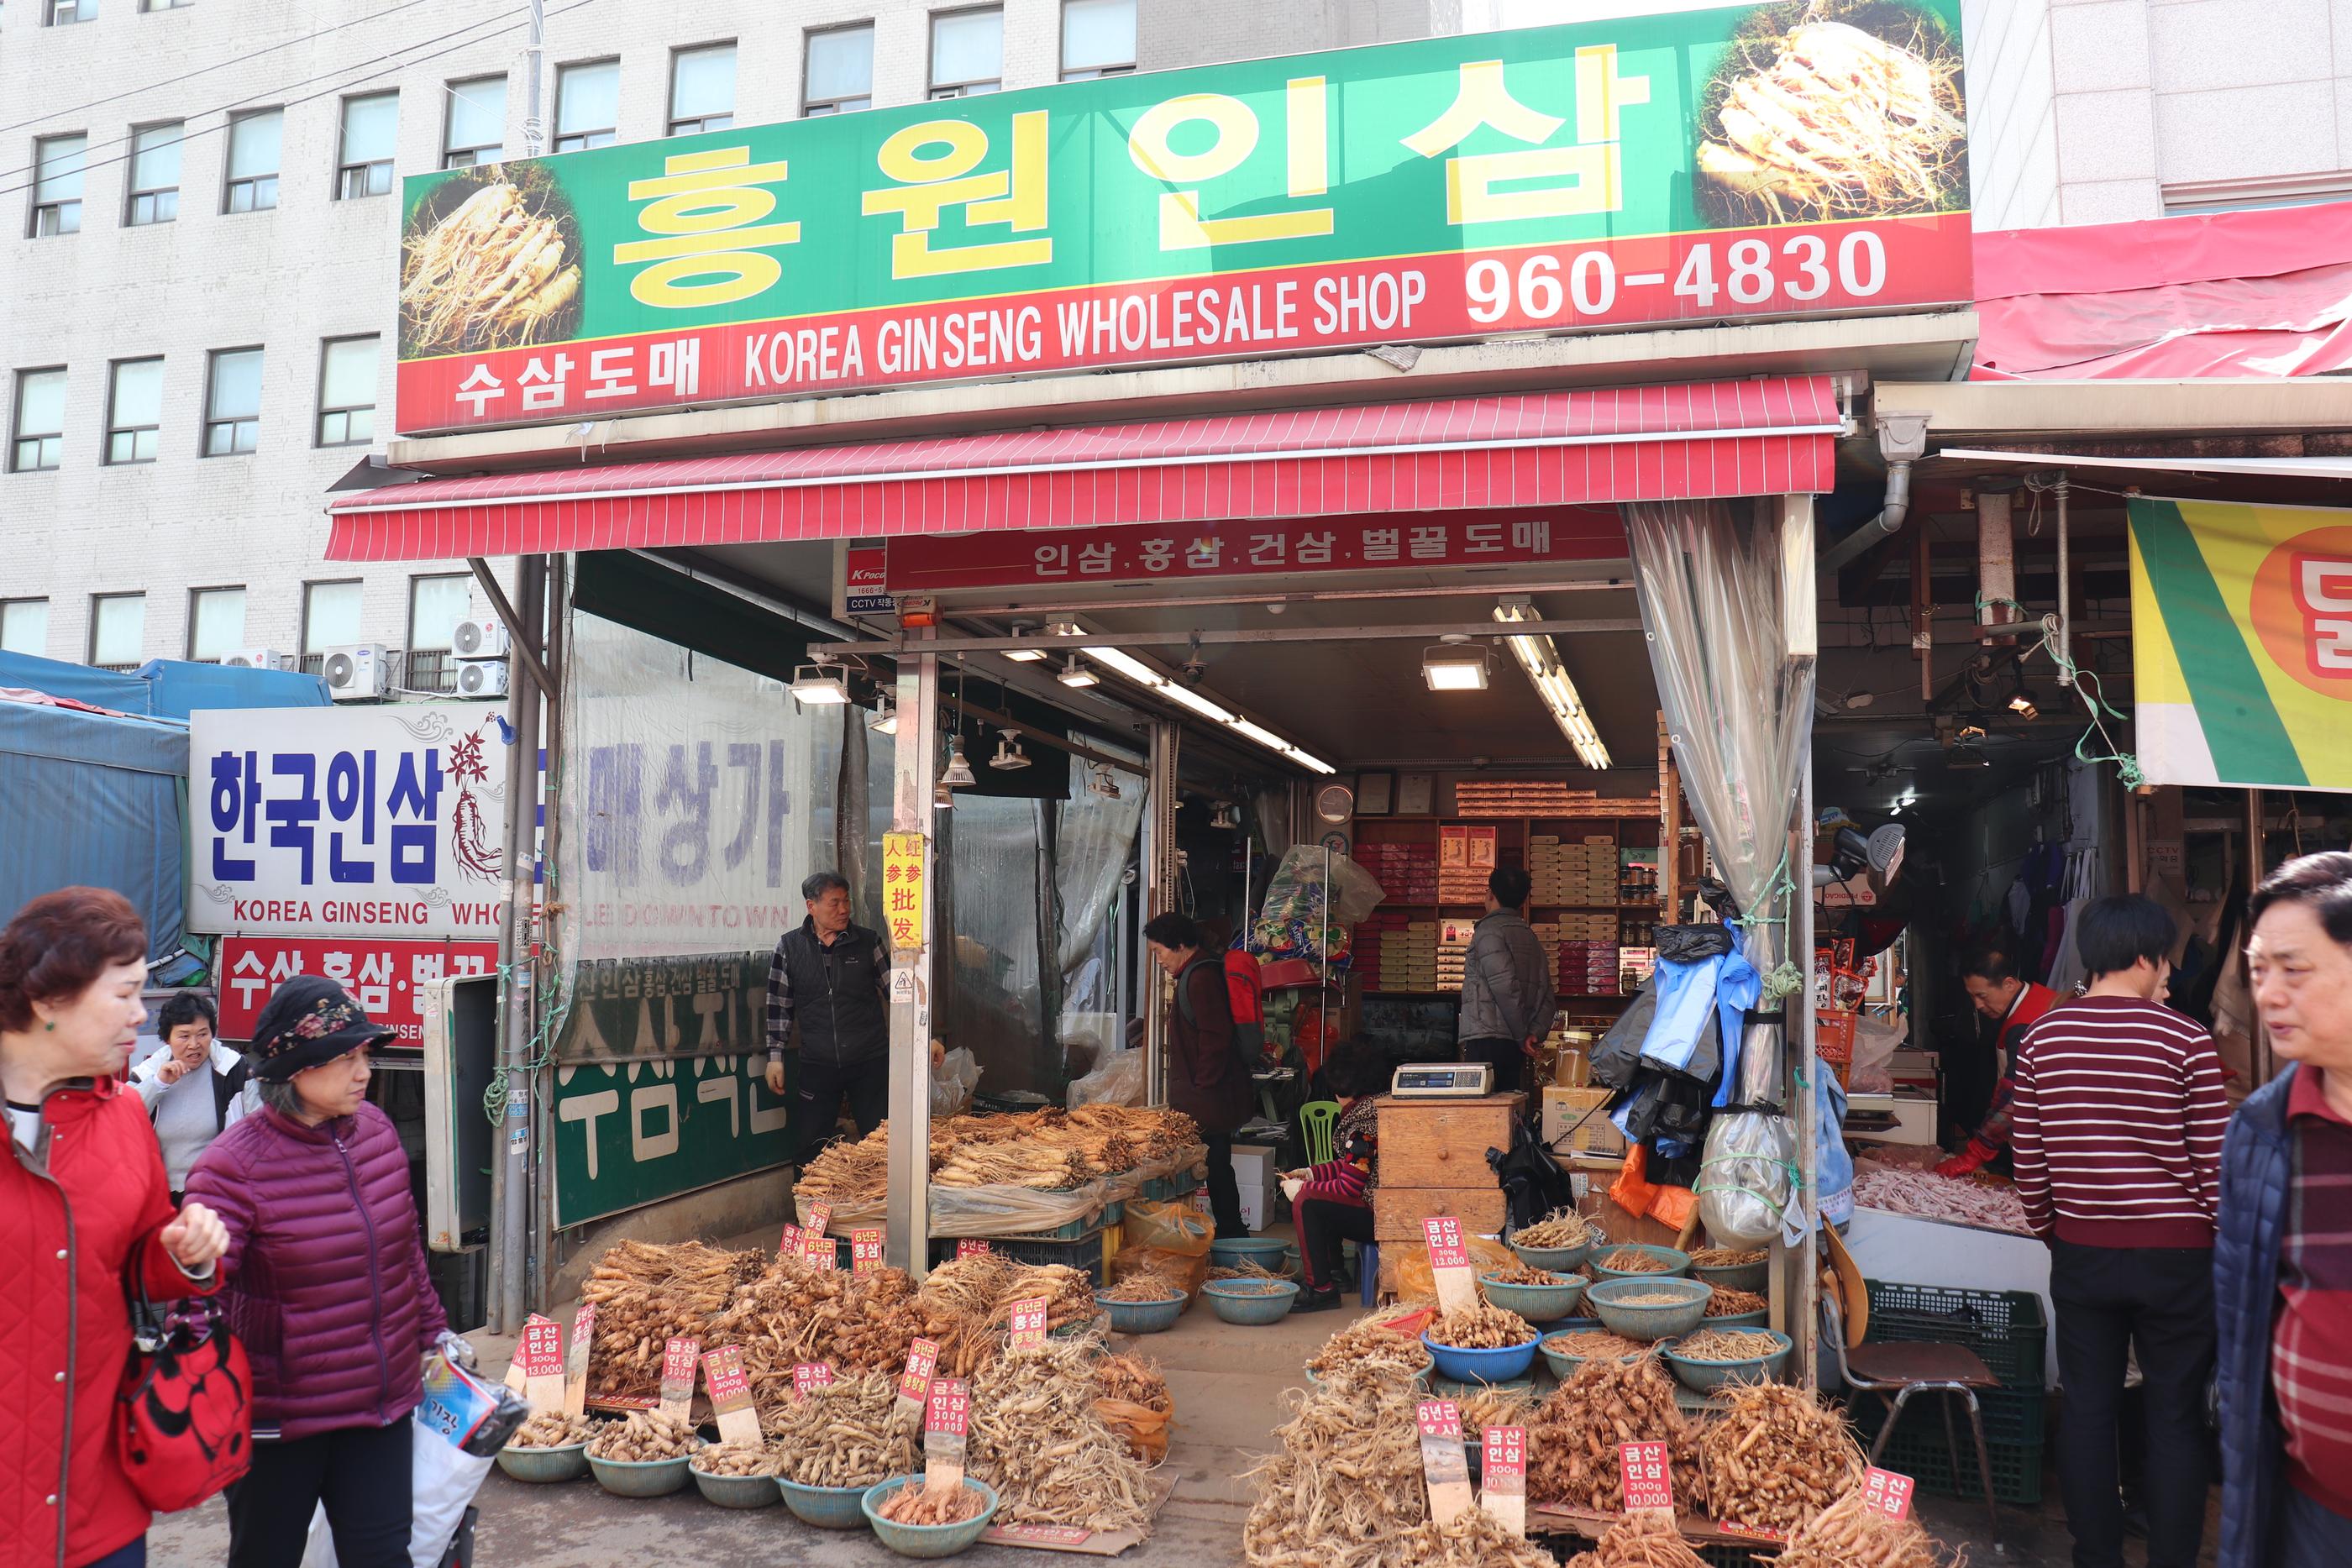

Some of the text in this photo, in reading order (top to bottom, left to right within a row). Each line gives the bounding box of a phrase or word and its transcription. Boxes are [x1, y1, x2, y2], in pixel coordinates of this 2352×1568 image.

[612, 44, 1651, 308] 흥원인삼
[745, 231, 1887, 387] KOREA GINSENG WHOLESALE SHOP 960-4830
[455, 338, 700, 417] 수삼도매
[1464, 521, 1551, 553] 도매
[851, 599, 876, 609] CCTV
[211, 739, 790, 888] 한국인삼 매상가
[234, 900, 313, 922] KOREA
[323, 901, 429, 924] GINSENG
[812, 1204, 828, 1217] 6년근
[807, 1214, 825, 1231] 홍삼
[1427, 1220, 1457, 1233] 금산
[855, 1231, 878, 1242] 6년근
[1429, 1234, 1459, 1247] 인삼
[807, 1241, 832, 1253] 6년근
[854, 1243, 879, 1259] 홍삼
[959, 1238, 988, 1251] 6년근
[1435, 1256, 1465, 1266] 12.000
[1016, 1301, 1042, 1314] 6년근
[1014, 1313, 1043, 1330] 홍삼
[528, 1326, 557, 1340] 금산
[528, 1340, 558, 1354] 인삼
[669, 1340, 696, 1354] 금산
[914, 1342, 935, 1359] 6년근
[668, 1354, 696, 1368] 인삼
[707, 1349, 738, 1366] 금산
[527, 1364, 562, 1376] 13.000
[667, 1366, 691, 1377] 300g
[711, 1363, 740, 1381] 인삼
[796, 1366, 827, 1378] 금산
[908, 1355, 932, 1377] 홍삼
[716, 1377, 742, 1389] 300g
[933, 1382, 964, 1395] 금산
[932, 1397, 966, 1411] 인삼
[934, 1412, 963, 1422] 300g
[1418, 1403, 1456, 1421] 6년근
[1488, 1430, 1521, 1445] 금산
[1488, 1447, 1521, 1463] 인삼
[1625, 1445, 1661, 1462] 금산
[1489, 1465, 1519, 1475] 300g
[1626, 1463, 1662, 1479] 인삼
[1630, 1481, 1662, 1492] 300g
[1868, 1472, 1908, 1497] 금산
